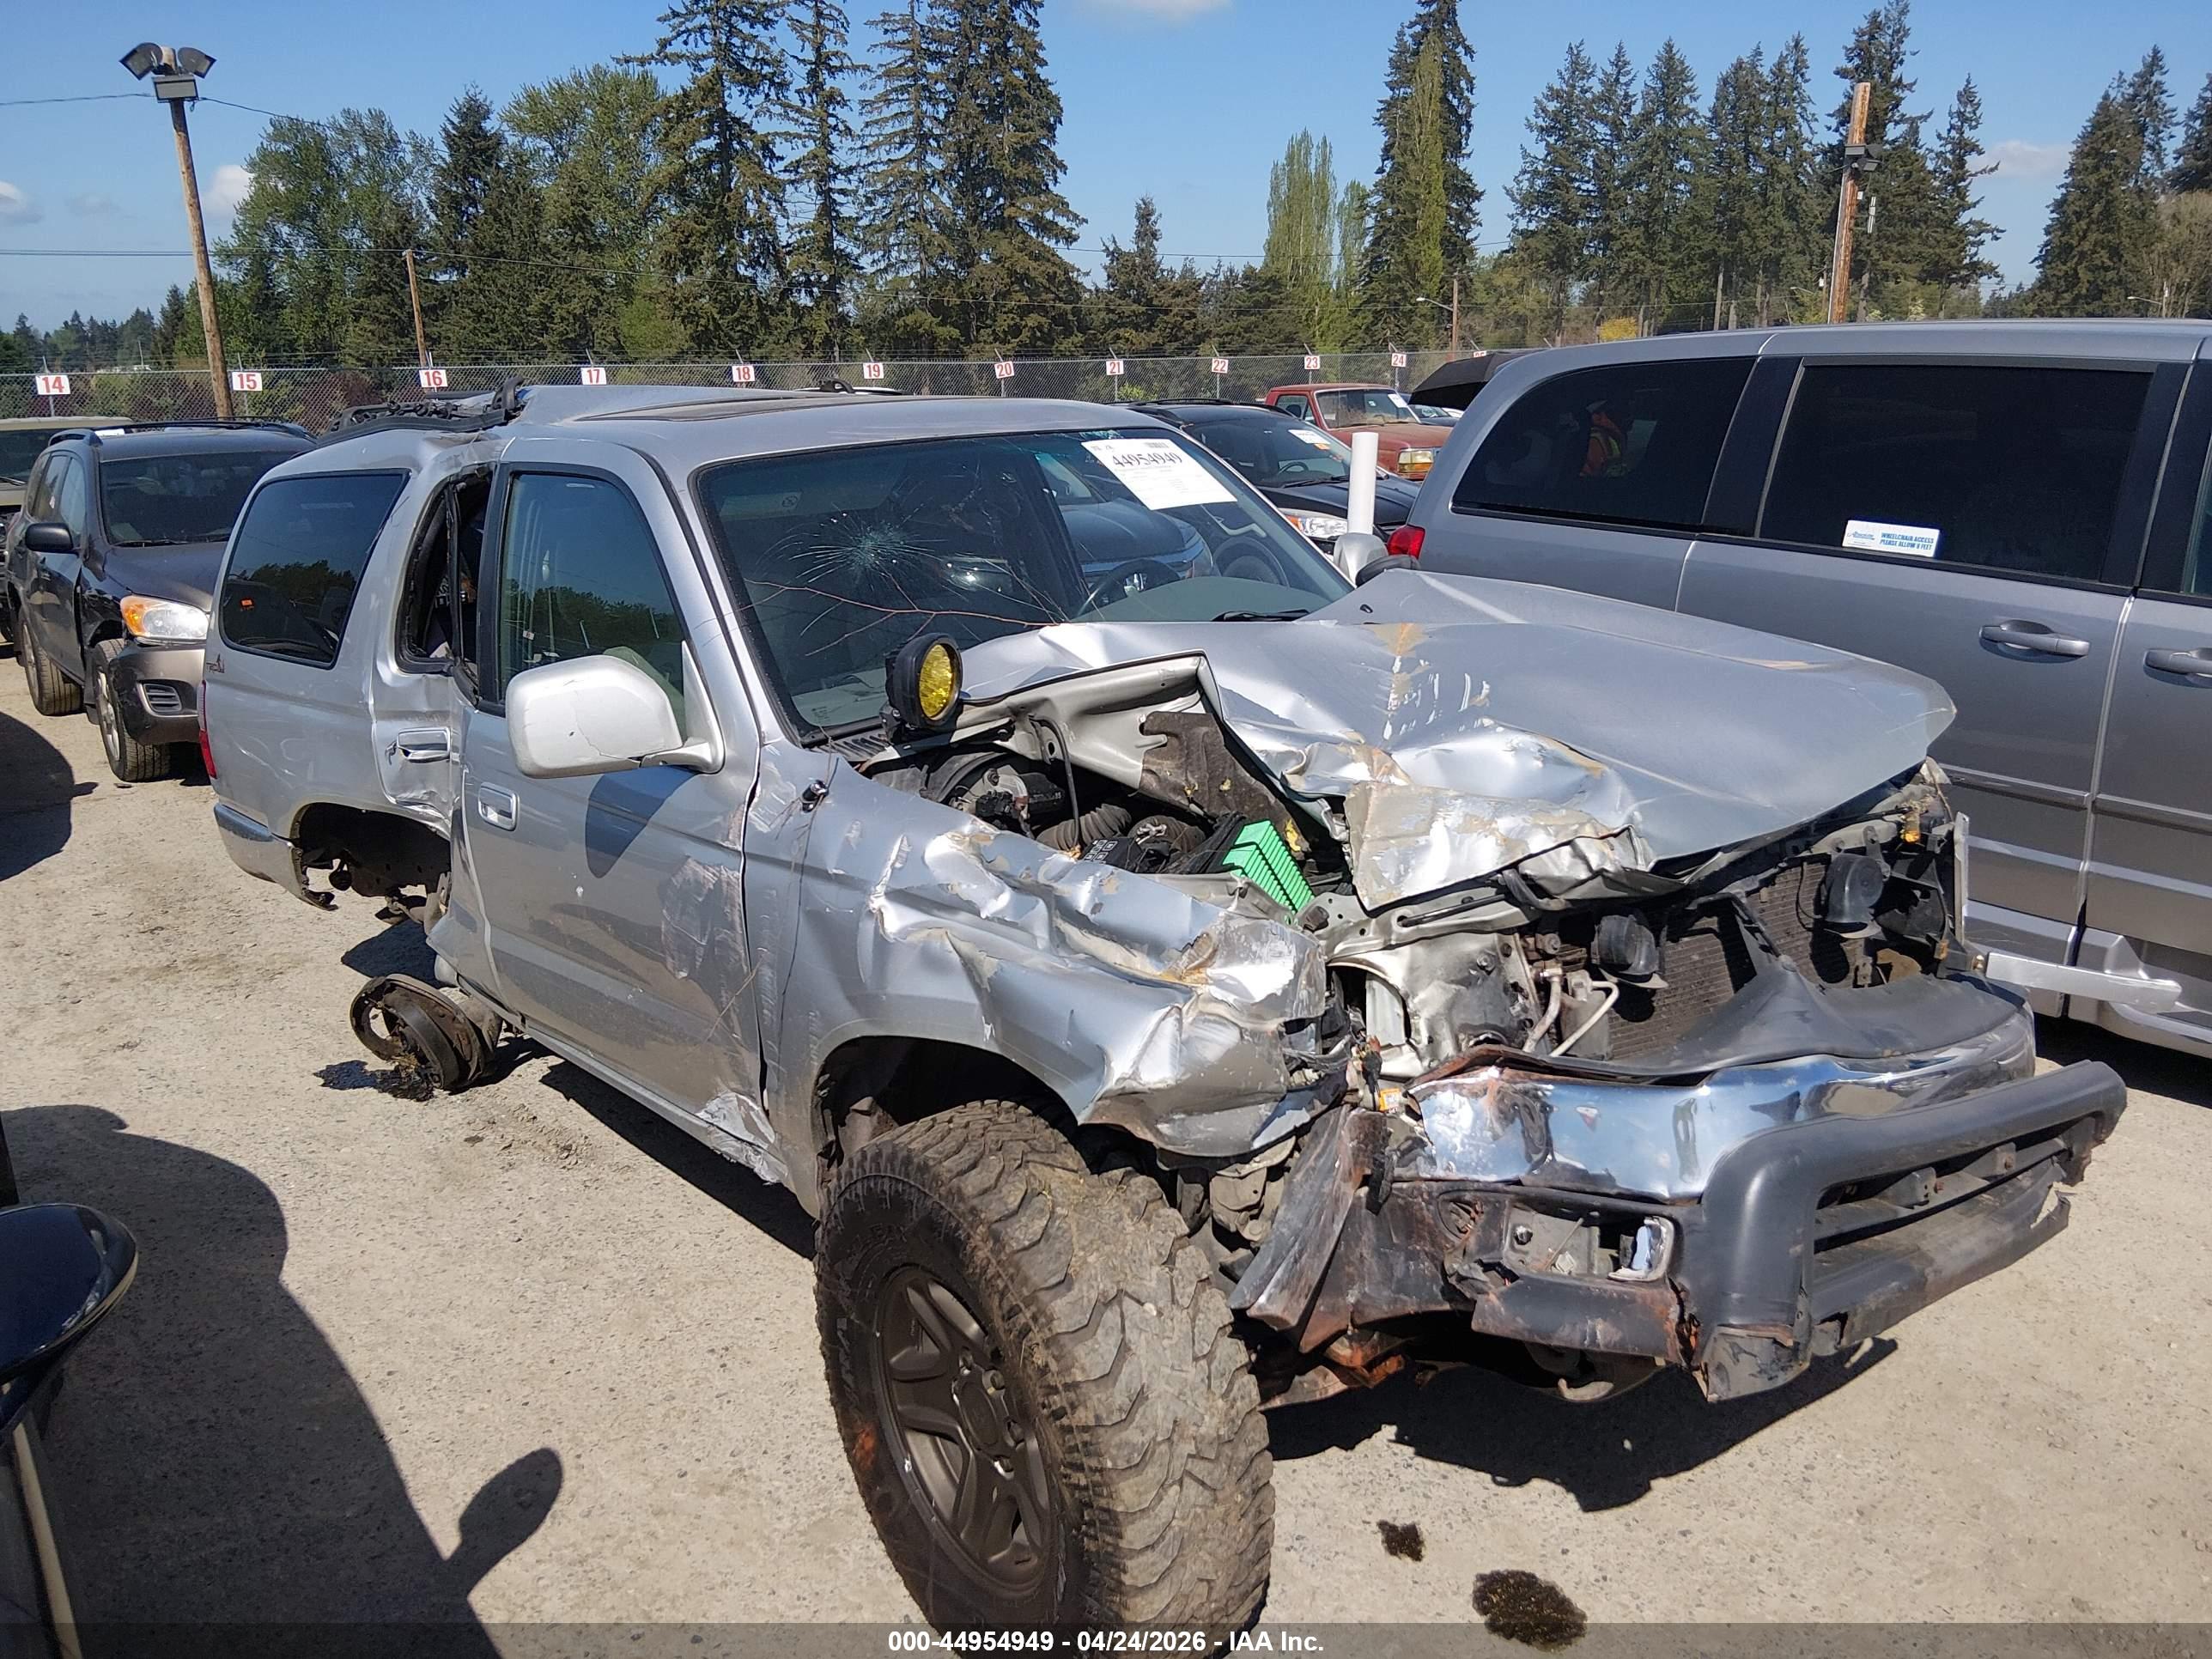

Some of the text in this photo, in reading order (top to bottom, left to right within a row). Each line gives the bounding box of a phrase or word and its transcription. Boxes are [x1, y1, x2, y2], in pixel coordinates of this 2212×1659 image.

[1109, 362, 1121, 374] 21
[1213, 360, 1226, 372] 22
[1306, 357, 1318, 368] 23
[1393, 355, 1405, 366] 24
[586, 369, 600, 385] 17
[735, 366, 750, 381] 18
[866, 363, 881, 378] 19
[997, 363, 1012, 377] 20
[42, 377, 64, 393] 14
[237, 374, 257, 390] 15
[423, 371, 443, 386] 16
[1112, 452, 1182, 467] 44954949
[1881, 532, 1935, 544] WHEELCHAIR ACCESS
